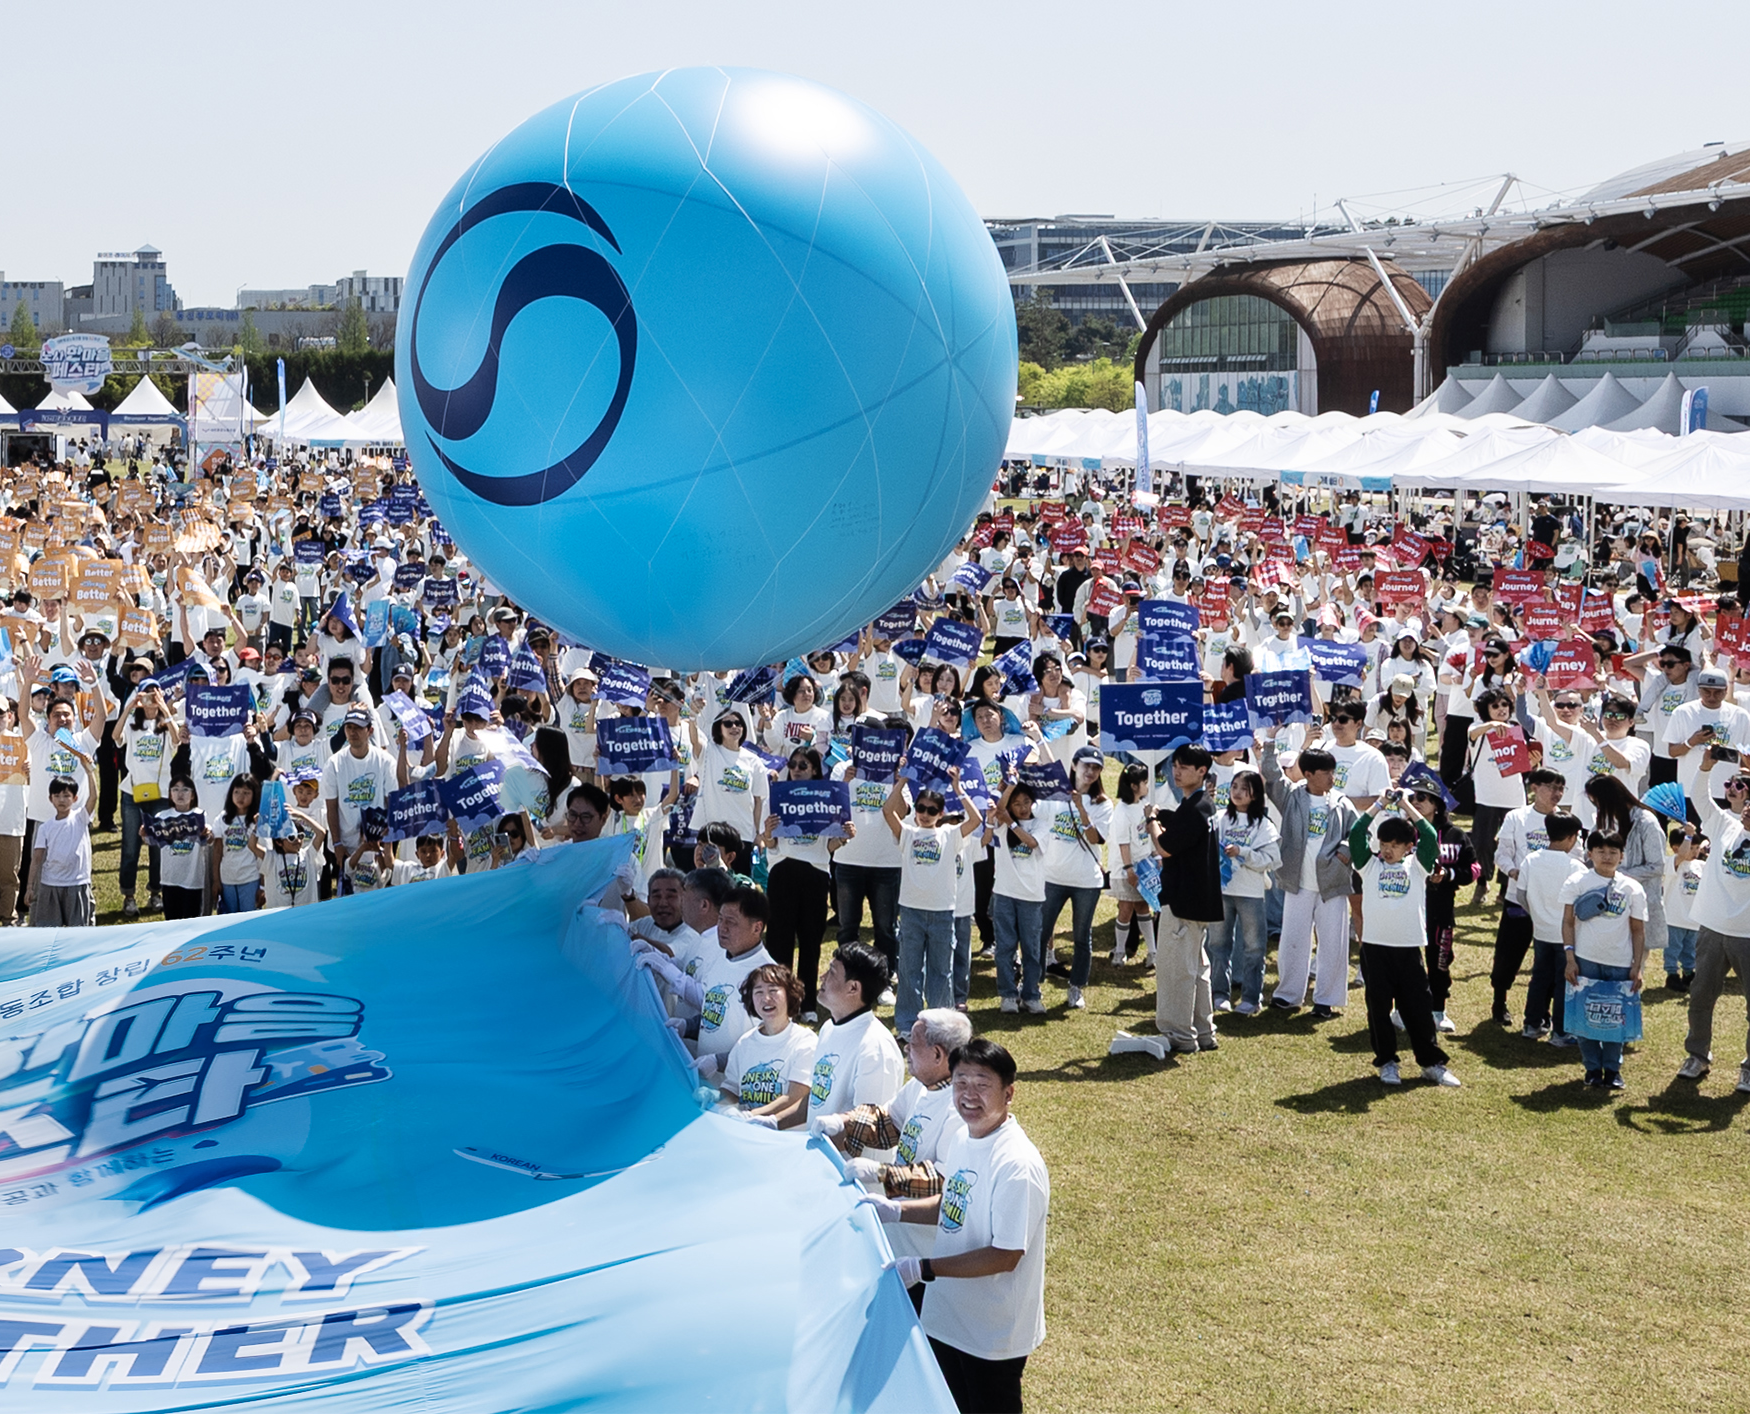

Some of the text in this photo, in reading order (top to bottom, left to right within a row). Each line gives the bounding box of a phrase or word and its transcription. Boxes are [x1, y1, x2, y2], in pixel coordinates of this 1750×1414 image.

[52, 361, 100, 379] 페스타
[394, 491, 416, 500] Together
[148, 535, 170, 543] Better
[1054, 537, 1082, 546] Journey
[1319, 536, 1343, 546] Journey
[297, 549, 322, 557] Together
[1130, 552, 1157, 569] Journey
[32, 577, 62, 587] Better
[1379, 582, 1420, 593] Journey
[1499, 581, 1538, 593] Journey
[76, 590, 110, 600] Better
[1580, 606, 1612, 620] Journe
[121, 619, 152, 634] Better
[1144, 617, 1192, 631] Together
[1526, 615, 1562, 627] Journe
[932, 631, 973, 652] Together
[1144, 656, 1195, 671] Together
[1550, 660, 1587, 674] urney
[191, 704, 241, 719] Together
[1114, 710, 1188, 728] Together
[607, 738, 665, 756] Together
[393, 801, 438, 822] Together
[780, 801, 842, 818] Together
[95, 958, 149, 986] 창립
[161, 944, 268, 968] 62주년
[741, 1070, 780, 1086] ONE SKY
[752, 1081, 776, 1093] ONE
[67, 1147, 176, 1188] 함께하는
